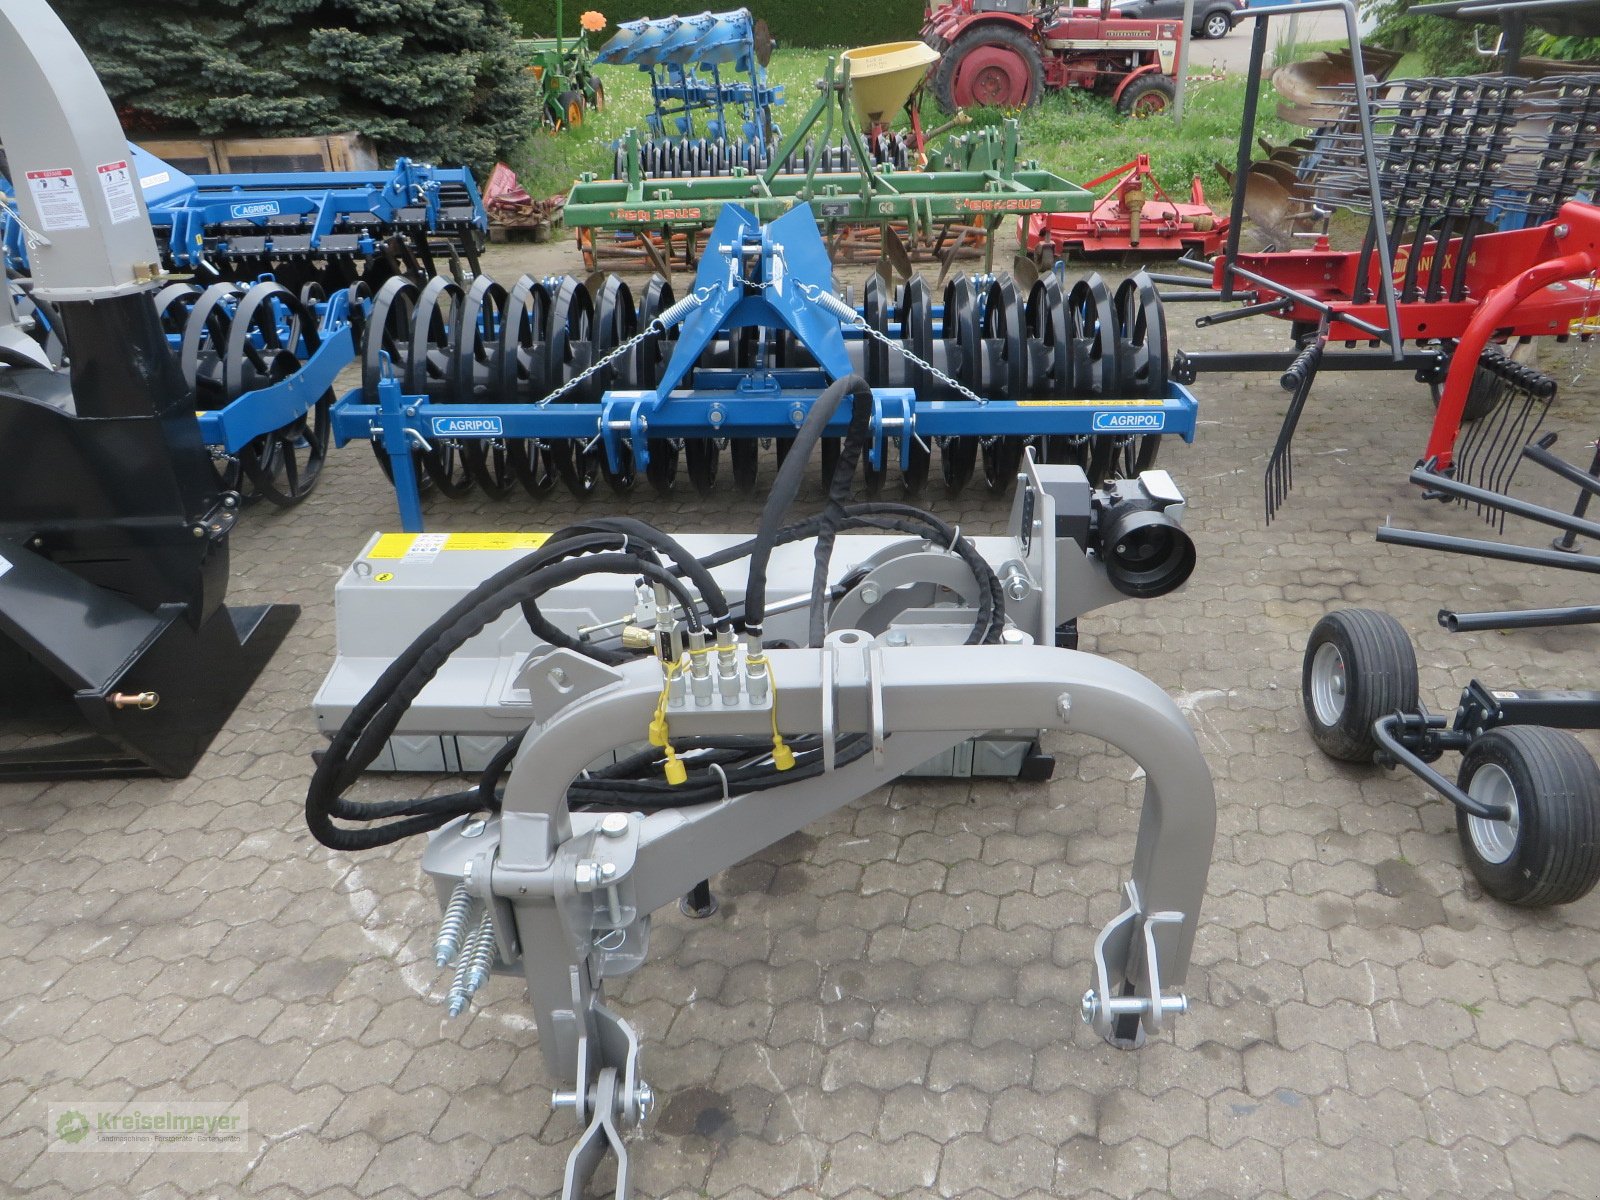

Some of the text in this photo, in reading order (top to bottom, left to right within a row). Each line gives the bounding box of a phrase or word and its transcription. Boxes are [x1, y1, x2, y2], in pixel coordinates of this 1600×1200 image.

[243, 204, 276, 214] AGRIPOL
[449, 420, 499, 430] AGRIPOL
[1110, 415, 1160, 425] AGRIPOL
